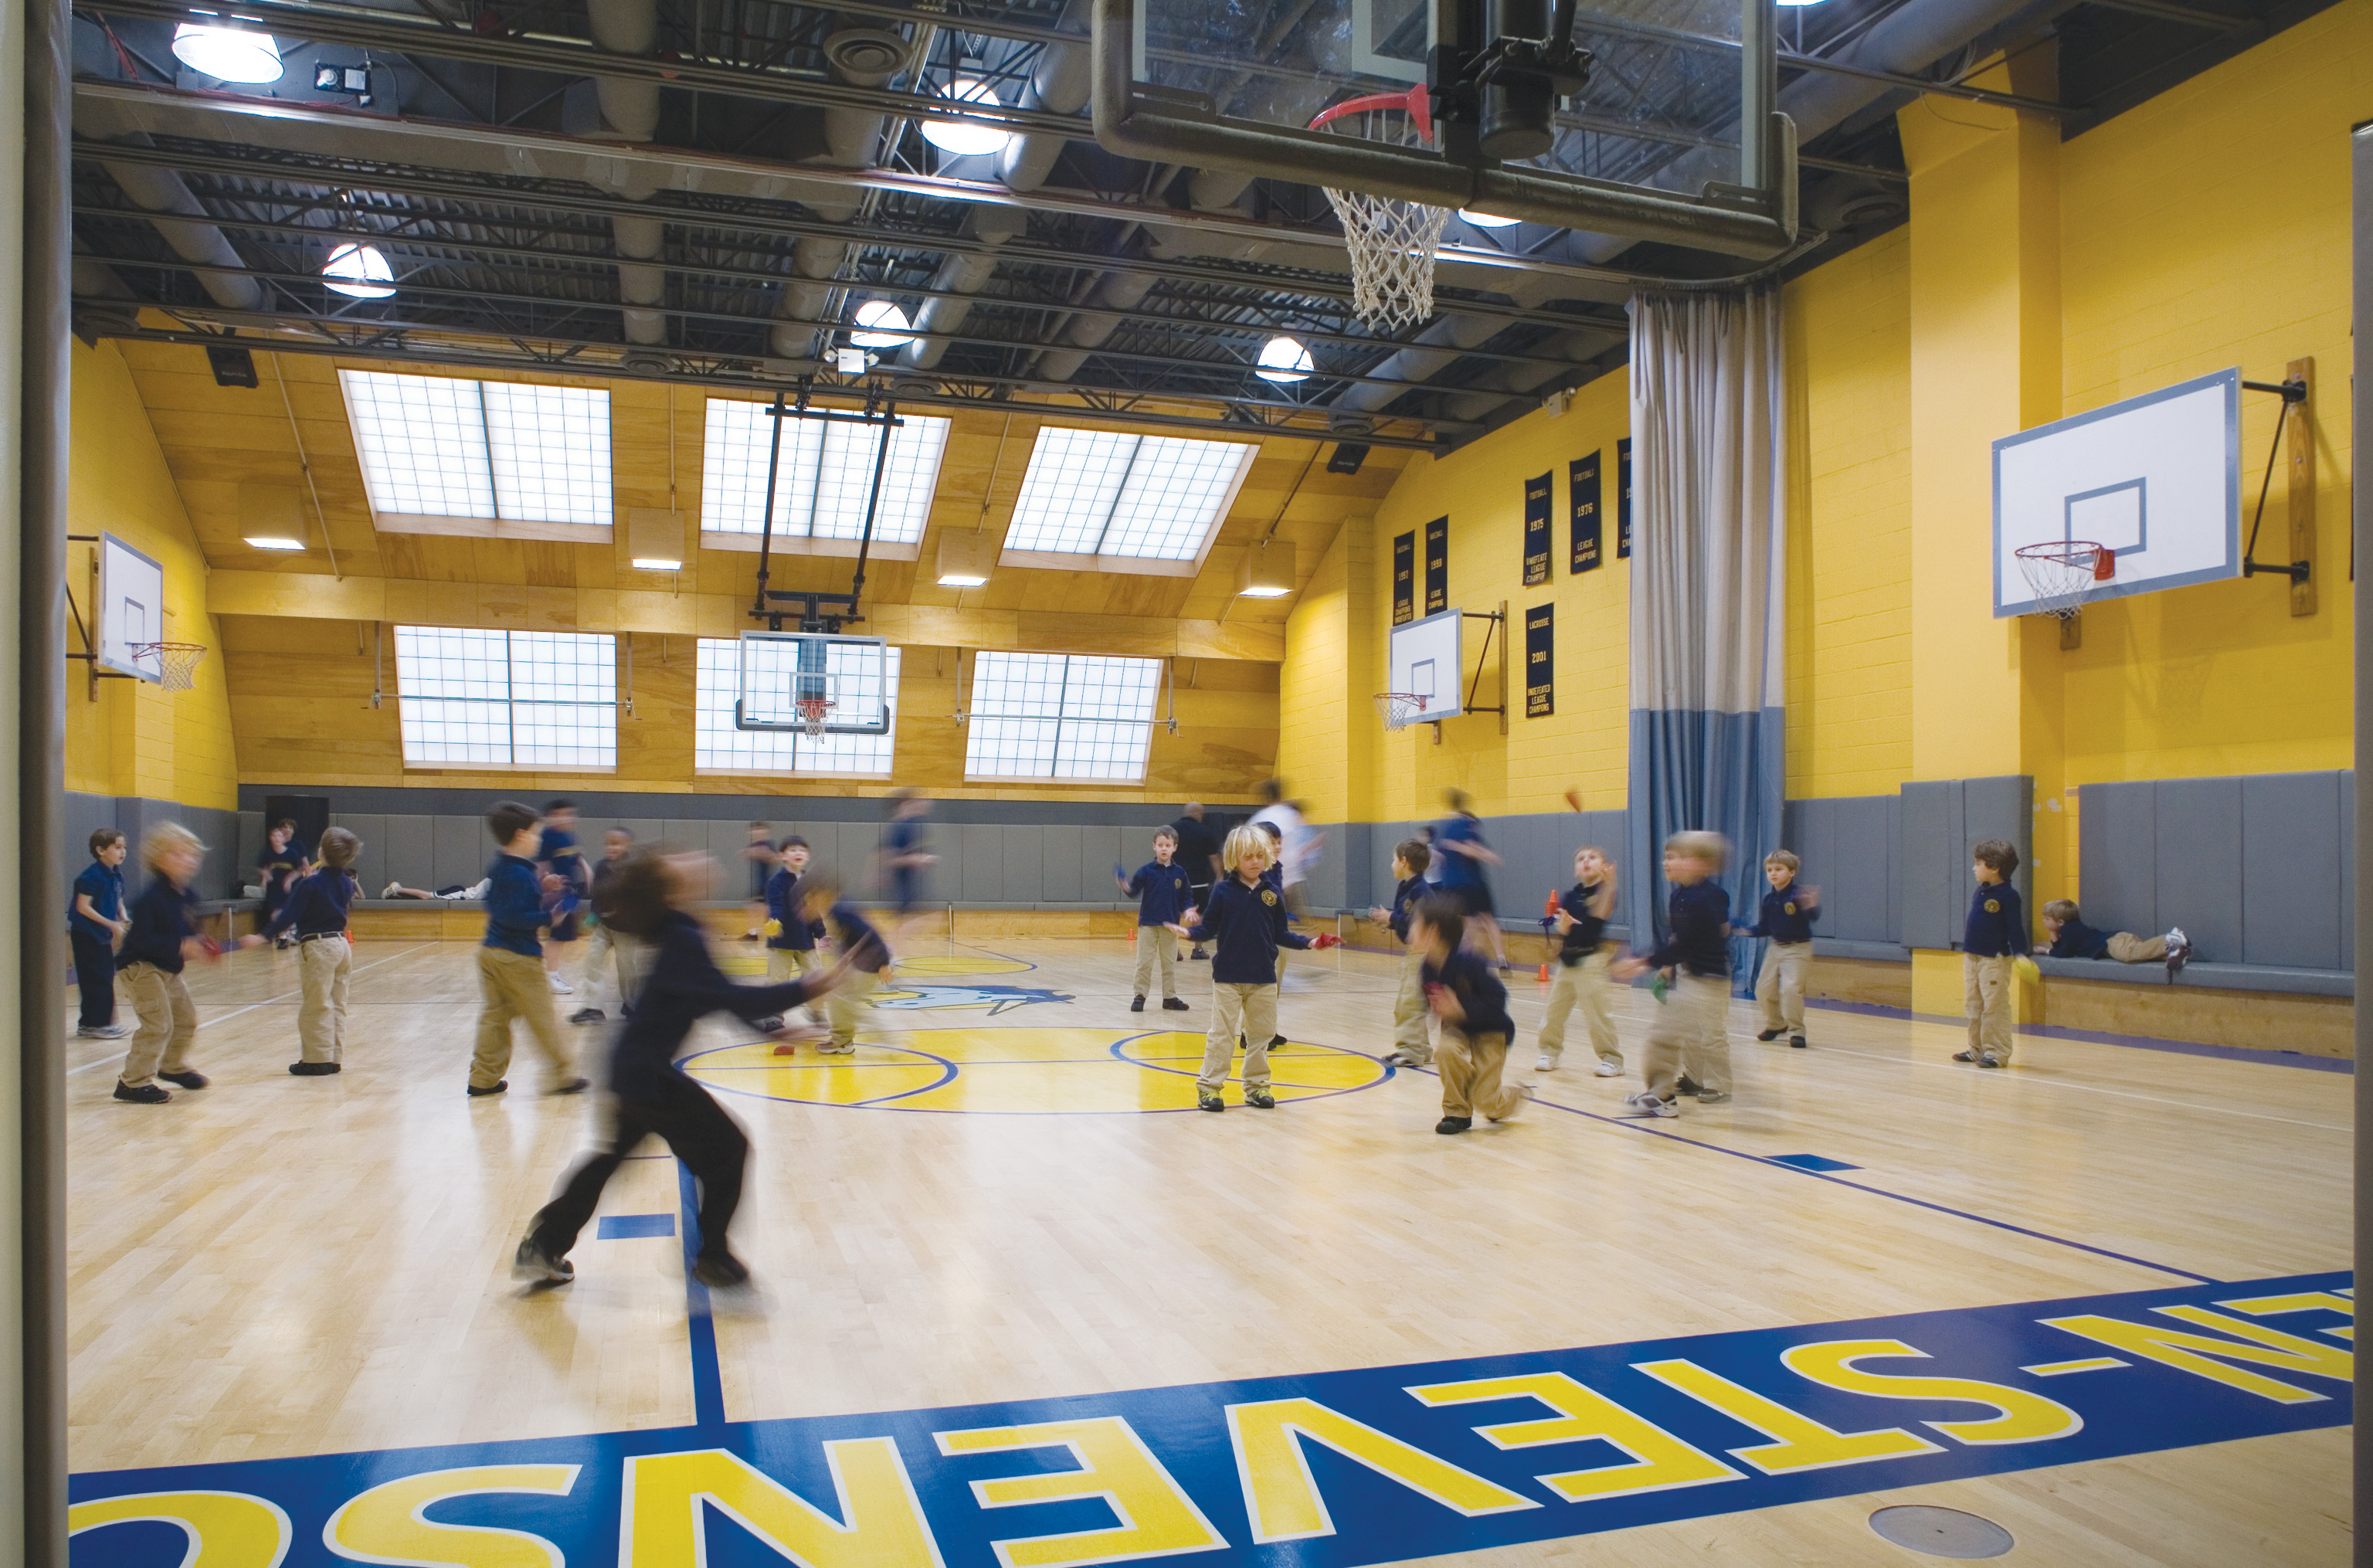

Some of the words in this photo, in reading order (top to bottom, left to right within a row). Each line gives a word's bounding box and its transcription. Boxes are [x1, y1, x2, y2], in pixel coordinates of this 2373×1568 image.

[1574, 468, 1594, 482] FOOTBALL
[1529, 487, 1547, 501] FOOTBALL
[1577, 503, 1593, 518] 1976
[1530, 518, 1544, 532] 1975
[1577, 538, 1594, 552] LEAGUE
[1526, 552, 1547, 565] UNDEFEATE
[1575, 549, 1597, 564] CHAMPIONS
[1529, 616, 1550, 630] LACROSSE
[1532, 650, 1546, 664] 2001
[1528, 684, 1550, 696] UNDEFEATED
[1531, 694, 1547, 705] LEAGUE
[1529, 704, 1550, 714] CHAMPIONS
